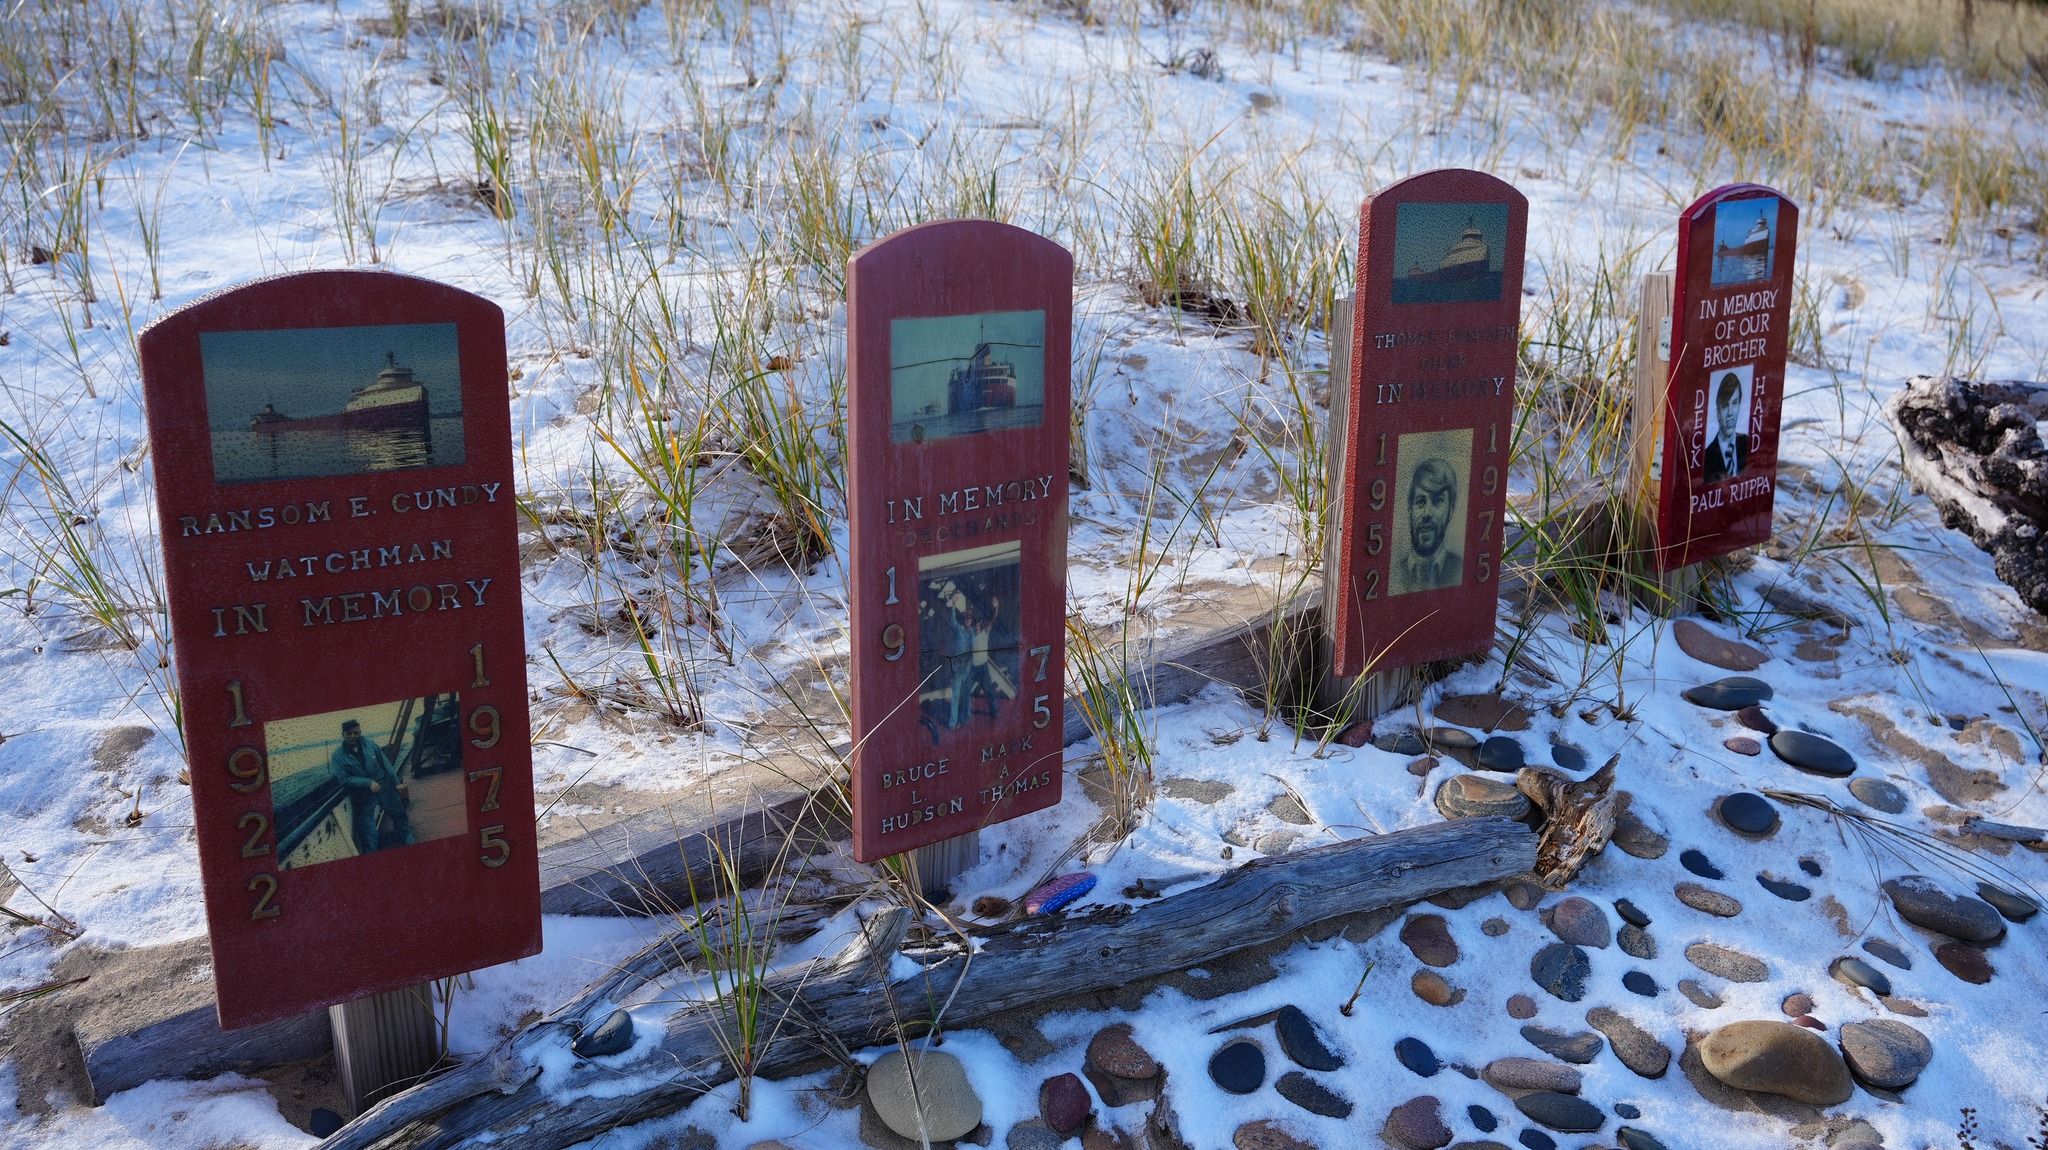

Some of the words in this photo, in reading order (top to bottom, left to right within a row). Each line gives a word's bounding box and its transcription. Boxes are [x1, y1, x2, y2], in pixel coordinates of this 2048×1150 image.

[1699, 299, 1718, 320] IN
[1723, 289, 1779, 317] MEMORY
[1714, 319, 1736, 341] OF
[1739, 313, 1770, 337] OUR
[1703, 338, 1767, 368] BROTHER
[1376, 383, 1404, 404] IN
[1690, 389, 1705, 469] DECK
[1750, 376, 1767, 454] HAND
[179, 501, 332, 538] RANSOM
[350, 496, 378, 518] E.
[391, 482, 502, 514] CUNDY
[887, 496, 923, 524] IN
[938, 475, 1054, 516] MEMORY
[1475, 422, 1499, 583] 1975
[1690, 488, 1725, 514] PAUL
[1729, 476, 1771, 504] RIIPPA
[1364, 432, 1388, 601] 1952
[246, 539, 454, 582] WATCHMAN
[211, 603, 269, 638] IN
[300, 578, 493, 627] MEMORY
[468, 642, 512, 869] 1975
[979, 735, 1034, 764] MAK
[882, 758, 950, 789] BRUCE
[979, 771, 1051, 804] THOMAS
[225, 679, 281, 920] 1922
[881, 797, 964, 835] HUDSON
[911, 789, 928, 806] L.
